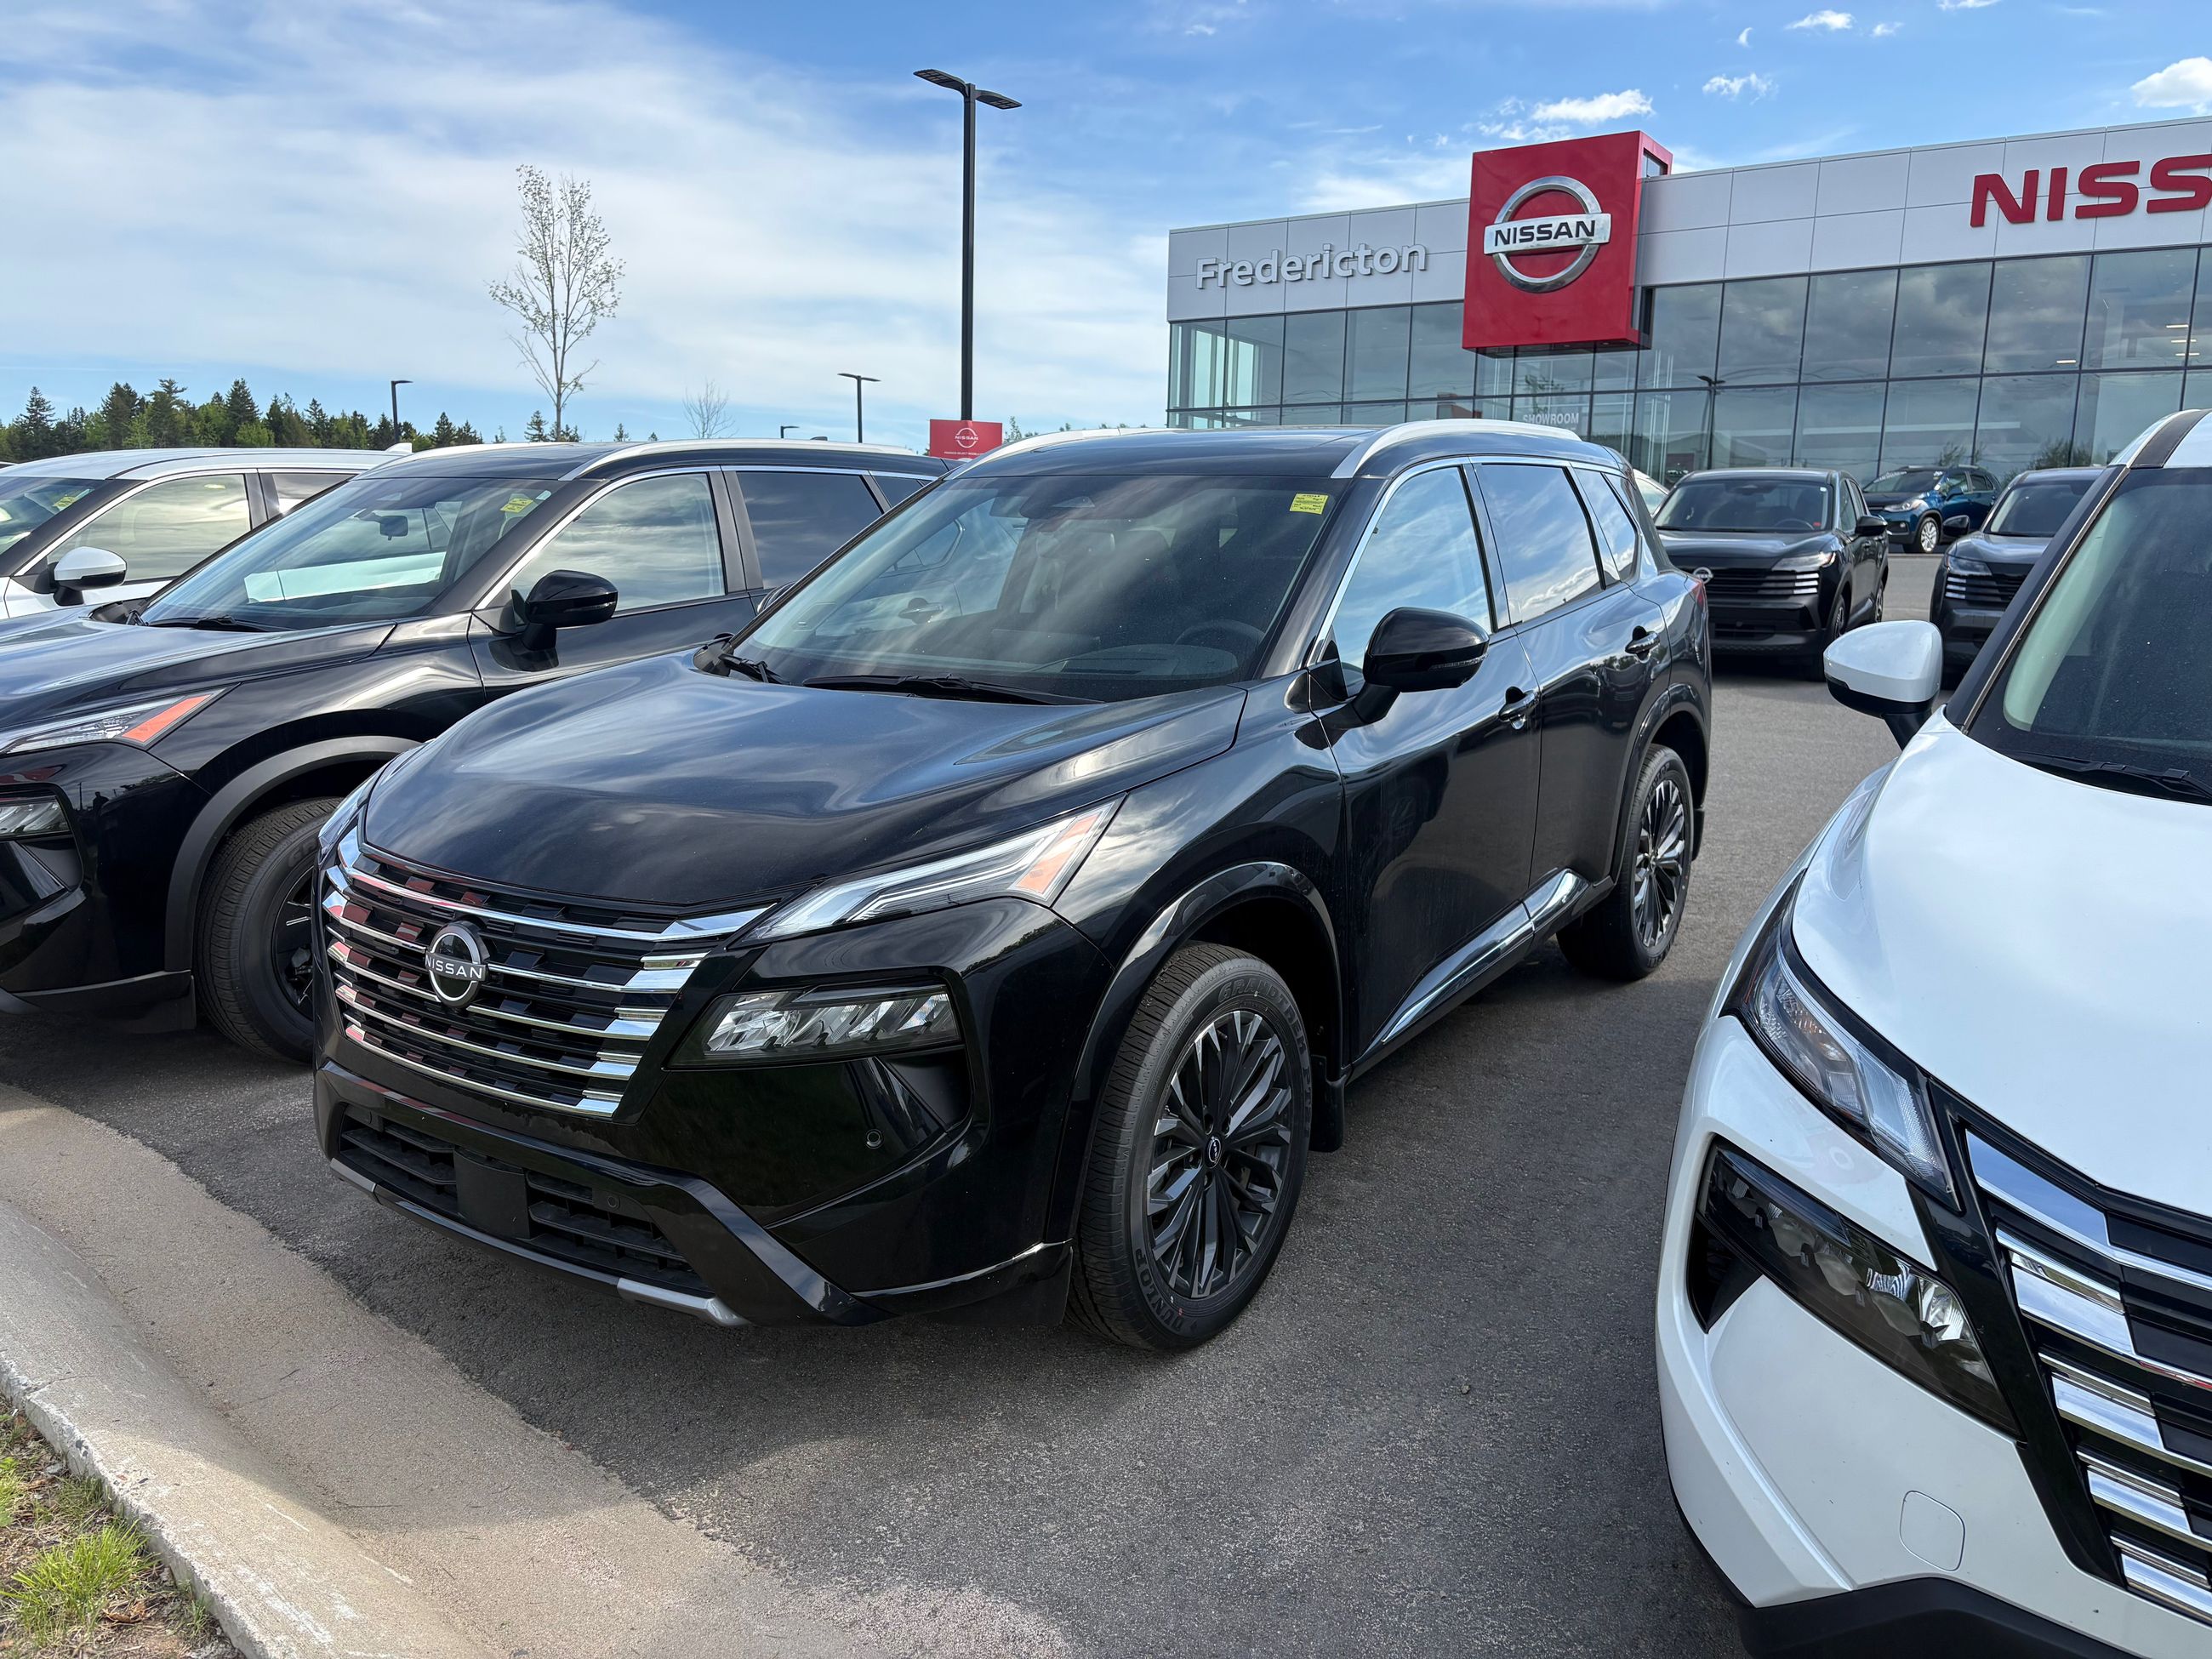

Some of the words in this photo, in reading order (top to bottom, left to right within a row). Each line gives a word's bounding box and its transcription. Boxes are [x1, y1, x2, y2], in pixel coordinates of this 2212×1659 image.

[1970, 153, 2212, 227] NISS
[1495, 220, 1595, 246] NISSAN
[1196, 243, 1427, 289] Fredericton
[1523, 412, 1579, 425] SHOWROOM
[425, 954, 482, 979] NISSAN
